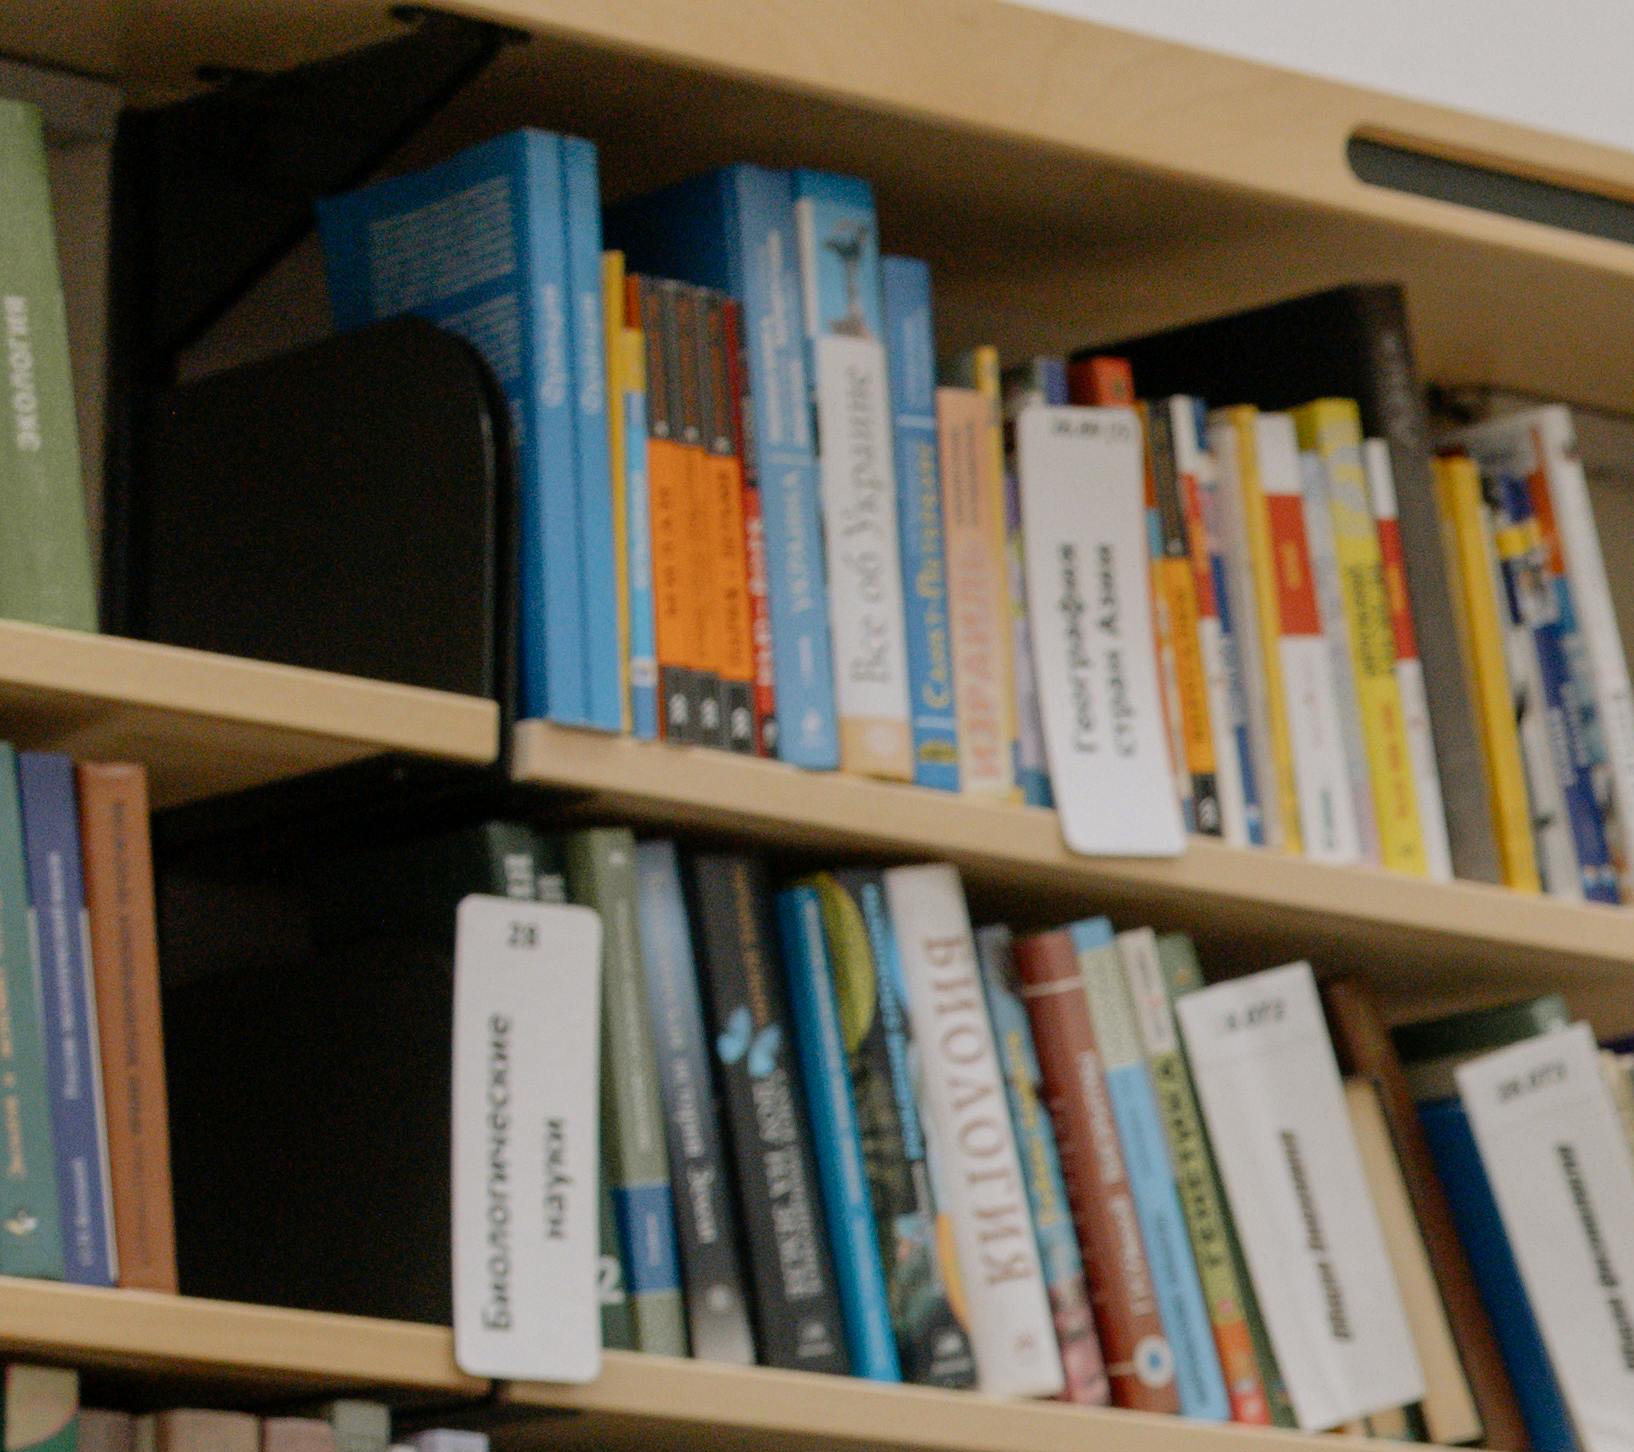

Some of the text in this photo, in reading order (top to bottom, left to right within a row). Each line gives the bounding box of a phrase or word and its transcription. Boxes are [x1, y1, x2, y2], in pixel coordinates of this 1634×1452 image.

[838, 366, 891, 684] Все об Украине
[1055, 542, 1096, 754] География
[1094, 543, 1139, 758] стран Азии
[507, 922, 537, 949] 28
[480, 1013, 514, 1333] Биологические
[540, 1116, 570, 1240] науки
[922, 935, 1030, 1288] БИОЛОГИЯ
